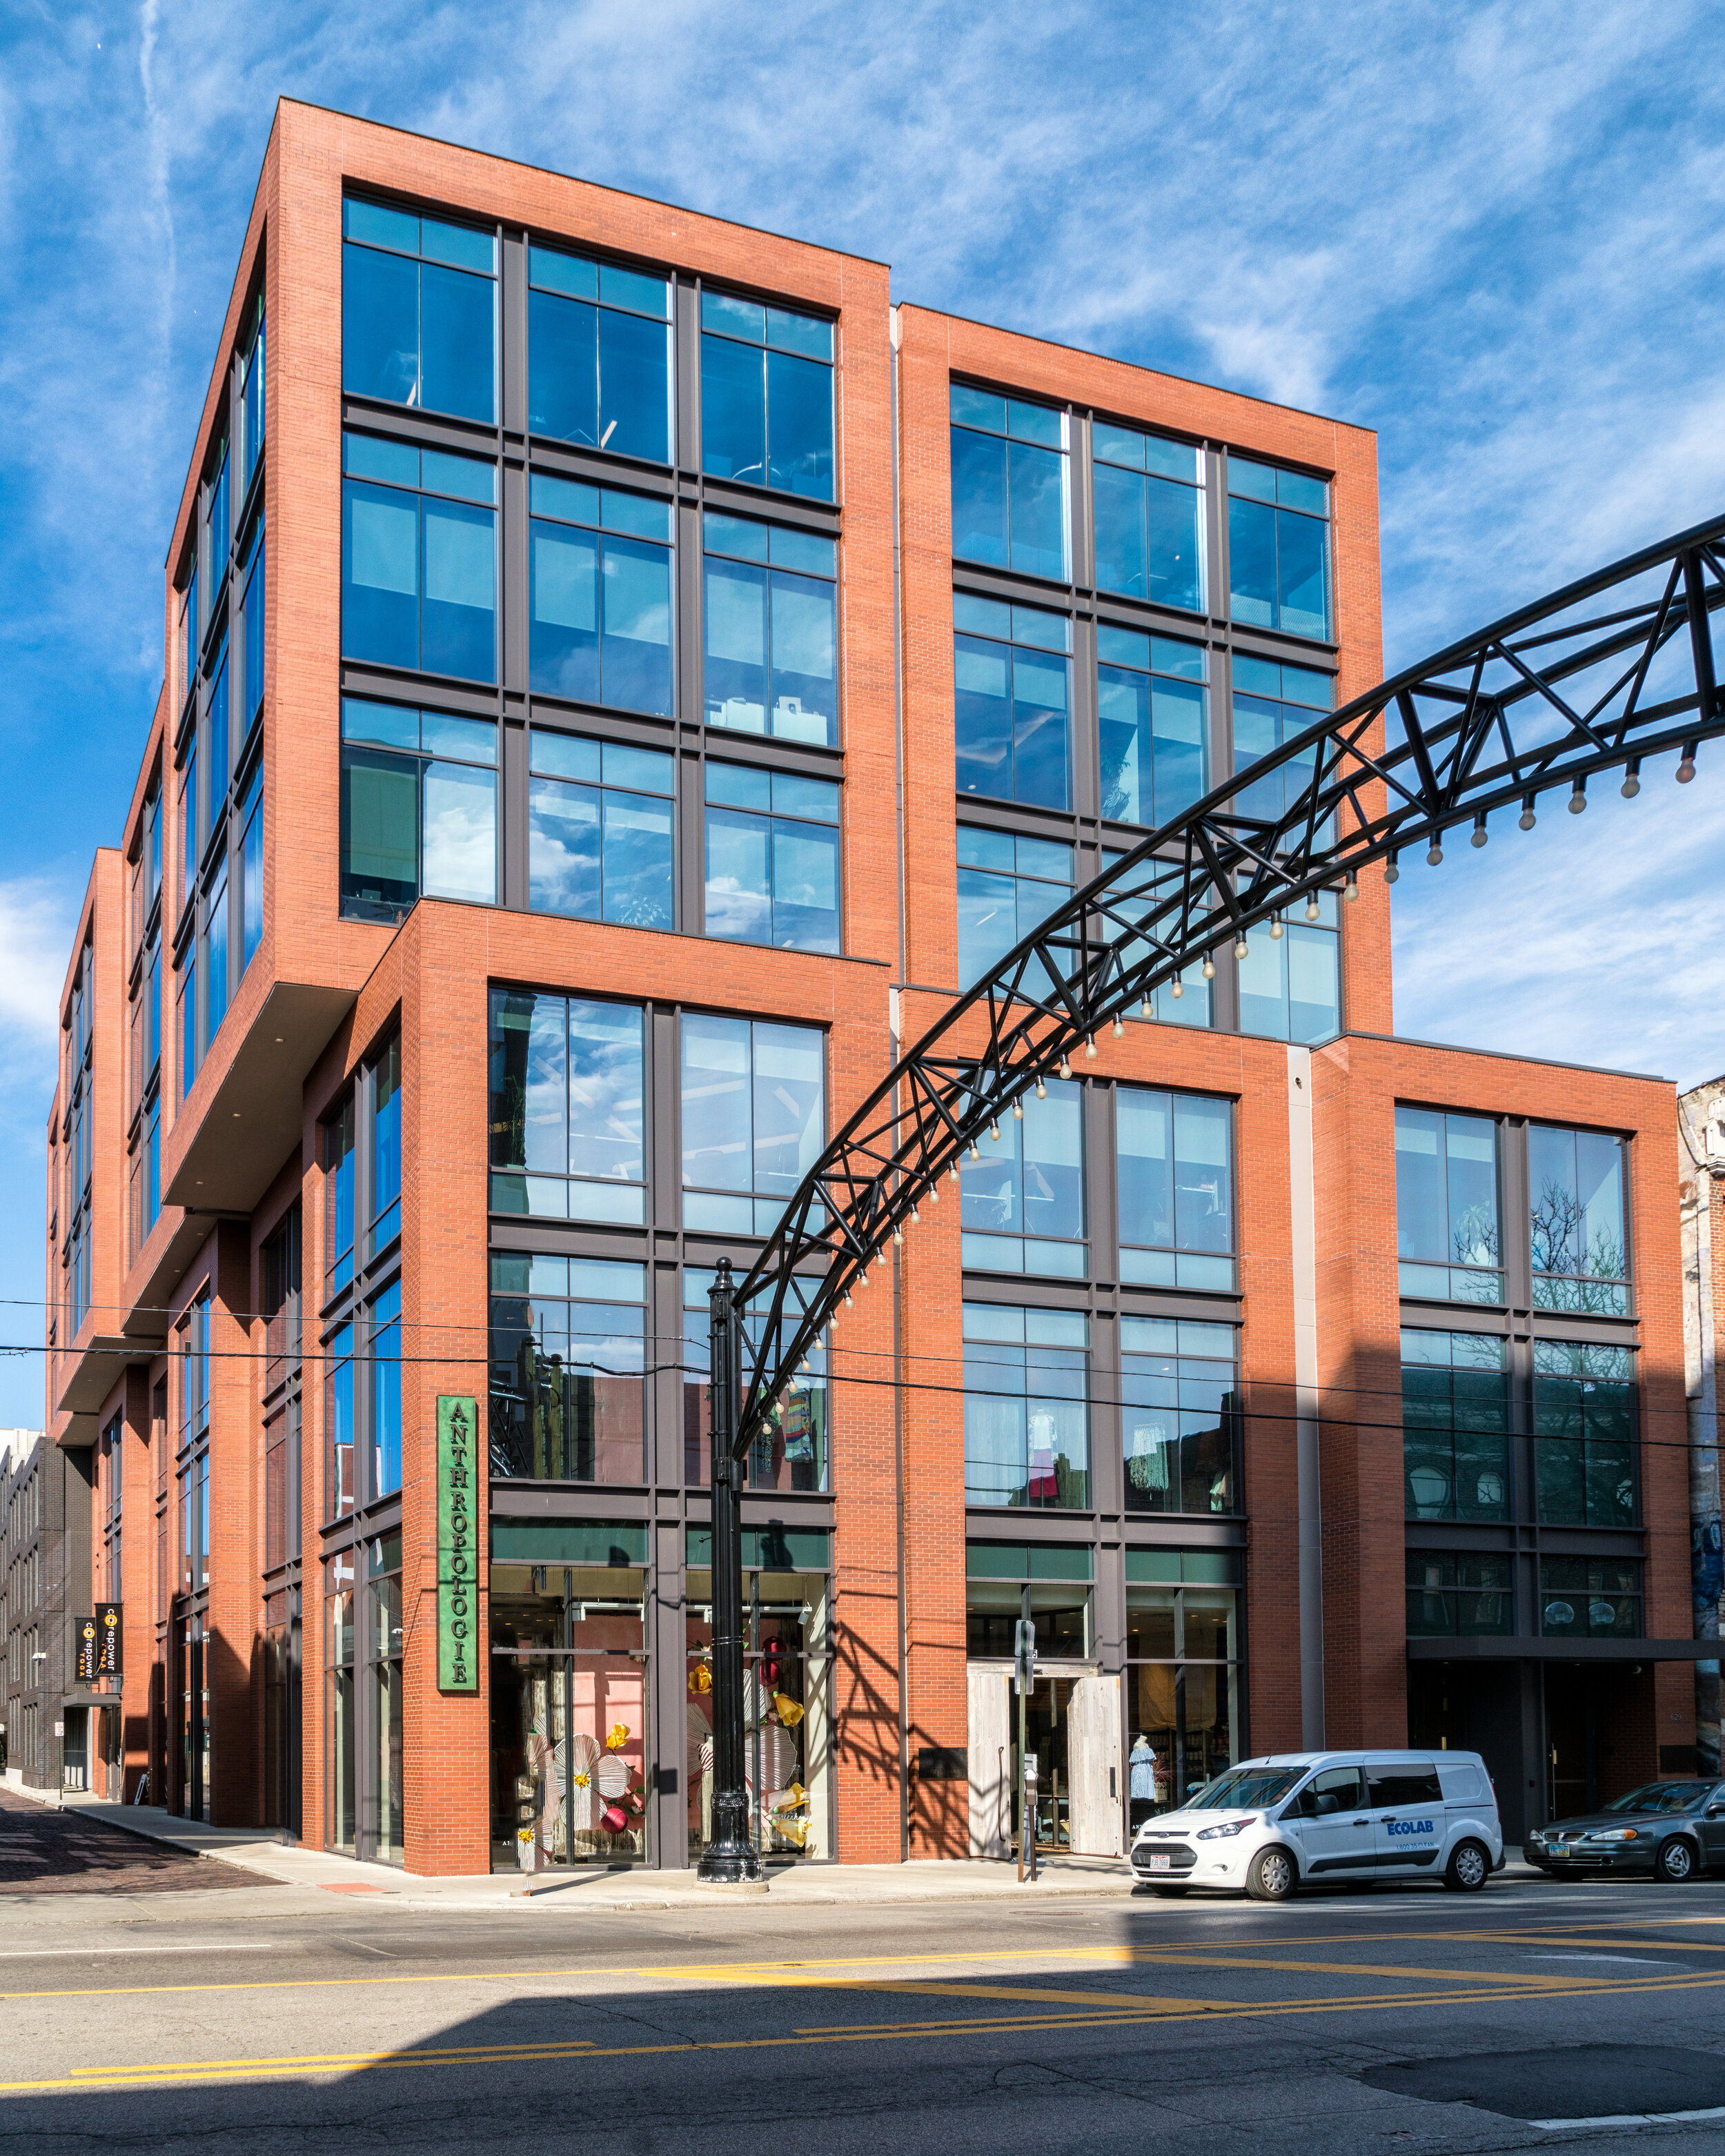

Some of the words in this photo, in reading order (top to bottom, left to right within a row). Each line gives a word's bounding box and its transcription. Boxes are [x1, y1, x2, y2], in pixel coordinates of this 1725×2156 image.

[449, 1402, 466, 1681] ANTHROPOLOGIE
[83, 1623, 95, 1678] corepower
[104, 1609, 117, 1670] corepower
[1670, 1713, 1682, 1721] 629
[1387, 1820, 1434, 1835] ECOLAB
